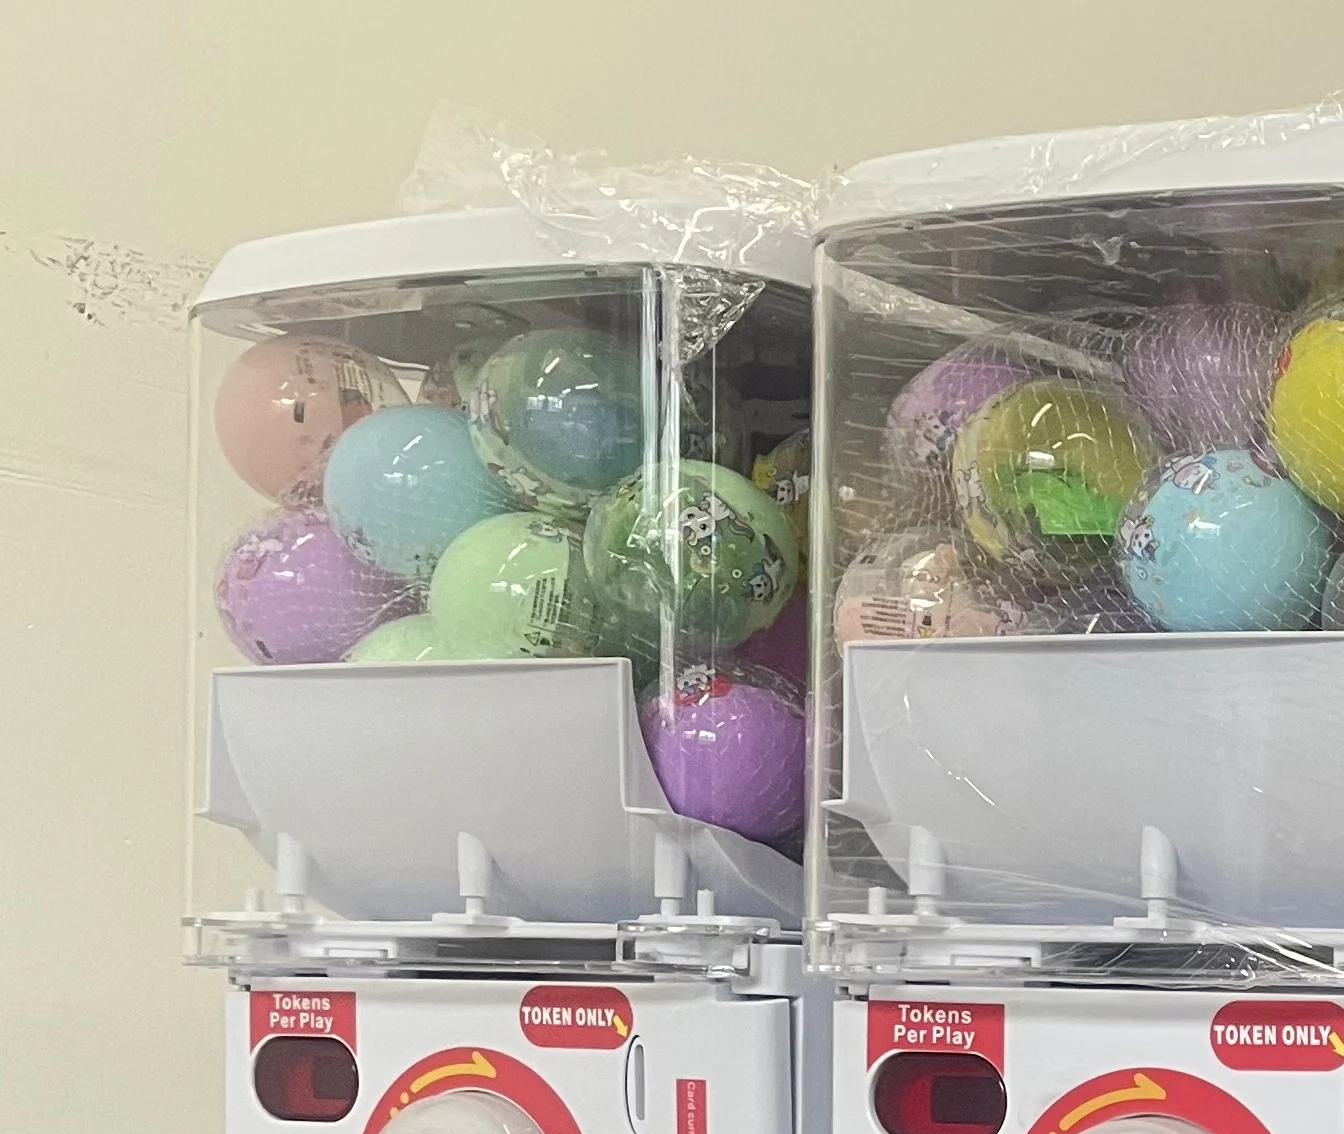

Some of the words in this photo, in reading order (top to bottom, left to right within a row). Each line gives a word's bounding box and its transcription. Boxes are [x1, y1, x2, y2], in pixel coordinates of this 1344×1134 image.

[272, 993, 331, 1011] Tokens
[269, 1011, 297, 1029] Per
[299, 1012, 334, 1034] Play
[521, 1006, 572, 1026] TOKEN
[575, 1007, 616, 1027] ONLY
[898, 1004, 972, 1024] Tokens
[893, 1024, 928, 1044] Per
[932, 1025, 975, 1050] Play
[1213, 1024, 1277, 1046] TOKEN
[1281, 1024, 1332, 1046] ONLY
